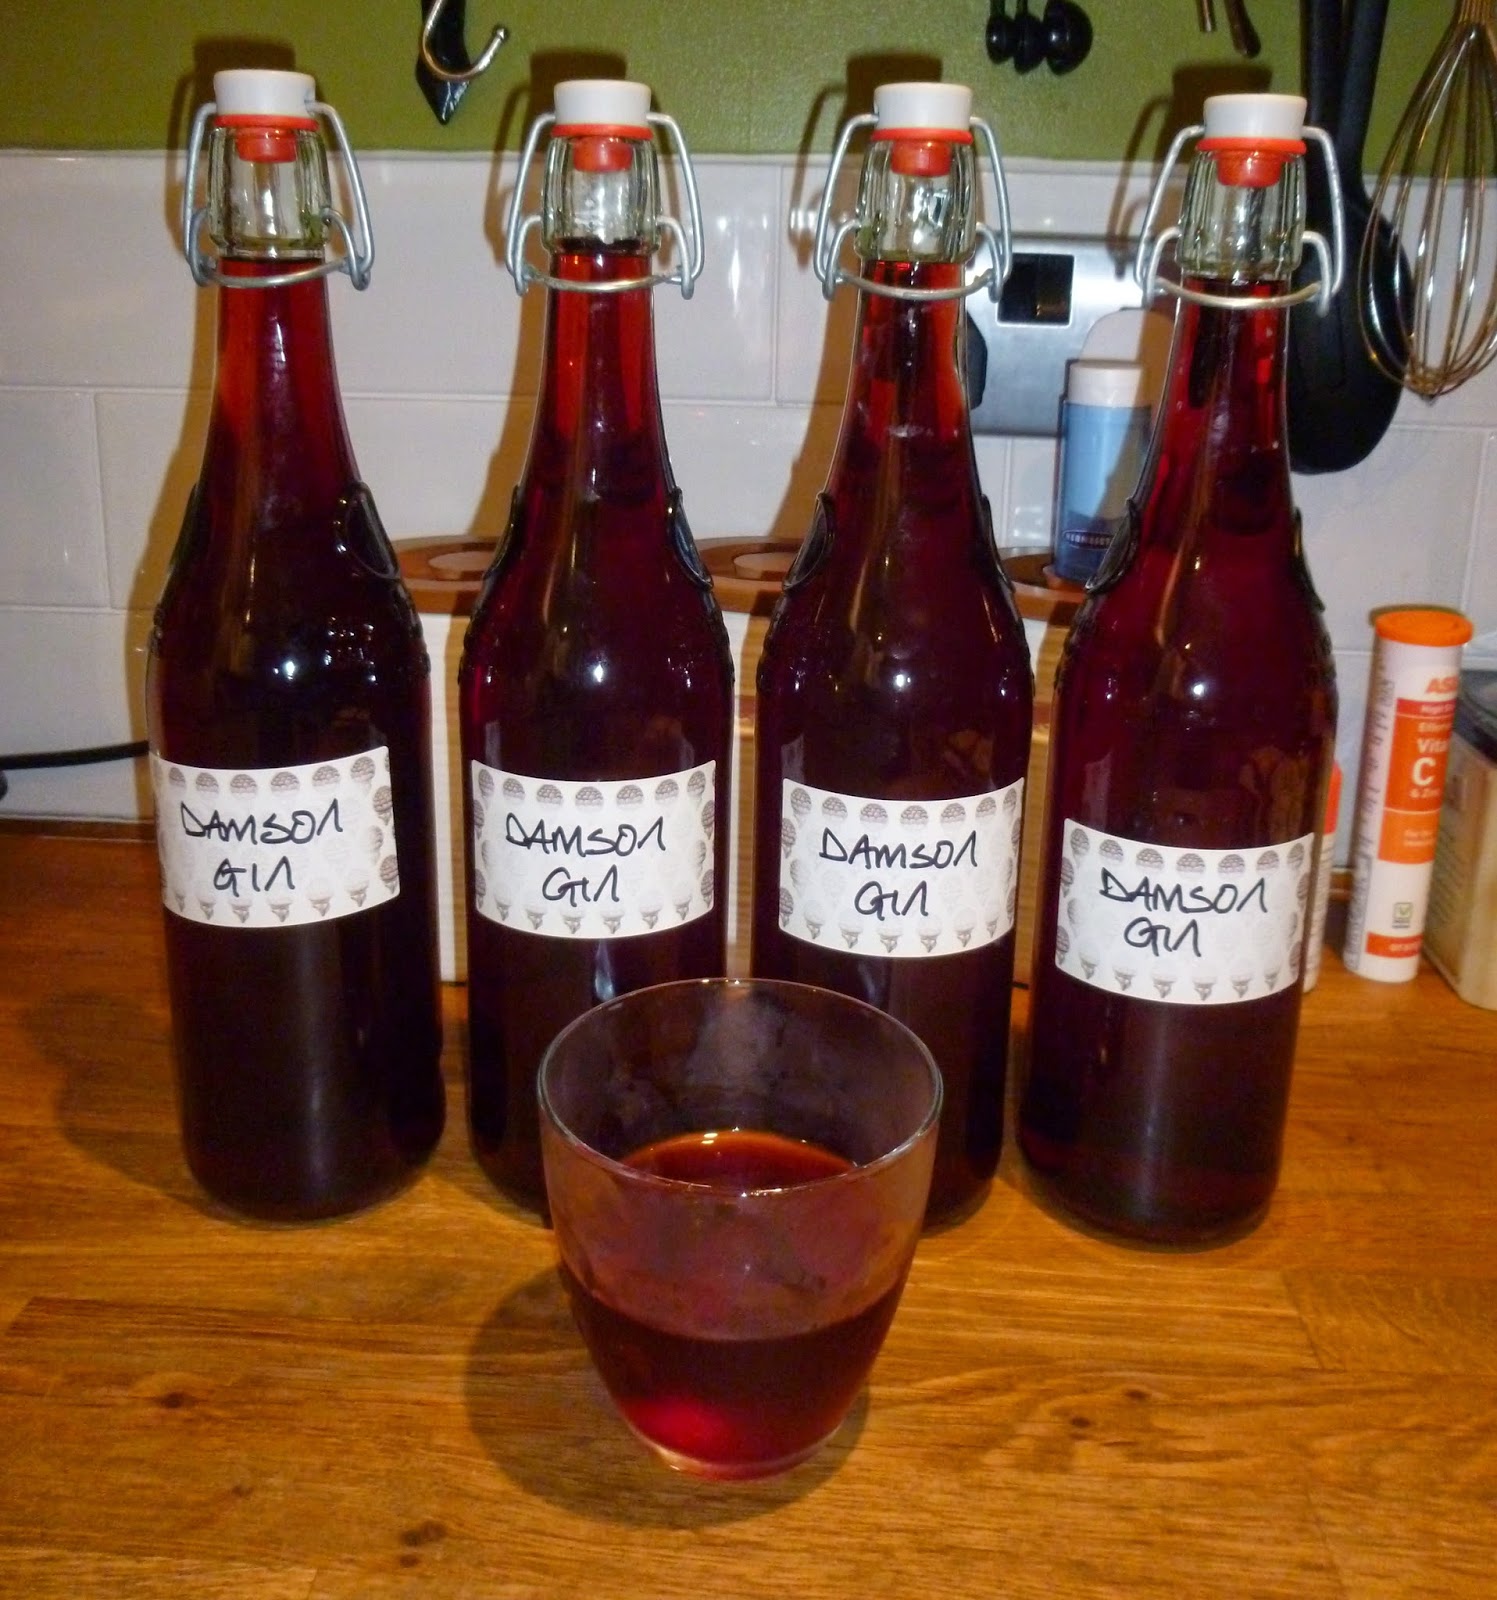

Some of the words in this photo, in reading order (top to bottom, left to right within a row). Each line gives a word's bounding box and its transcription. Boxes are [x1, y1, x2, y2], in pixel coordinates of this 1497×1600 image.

[1412, 757, 1436, 786] C
[181, 798, 343, 845] DAMSON
[506, 812, 666, 857] DAMSON
[819, 827, 977, 870] DAMSON
[213, 856, 295, 897] GIN
[542, 864, 620, 907] GIN
[1099, 867, 1267, 914] DAMSON
[854, 881, 928, 921] GIN
[1124, 916, 1201, 957] GIN
